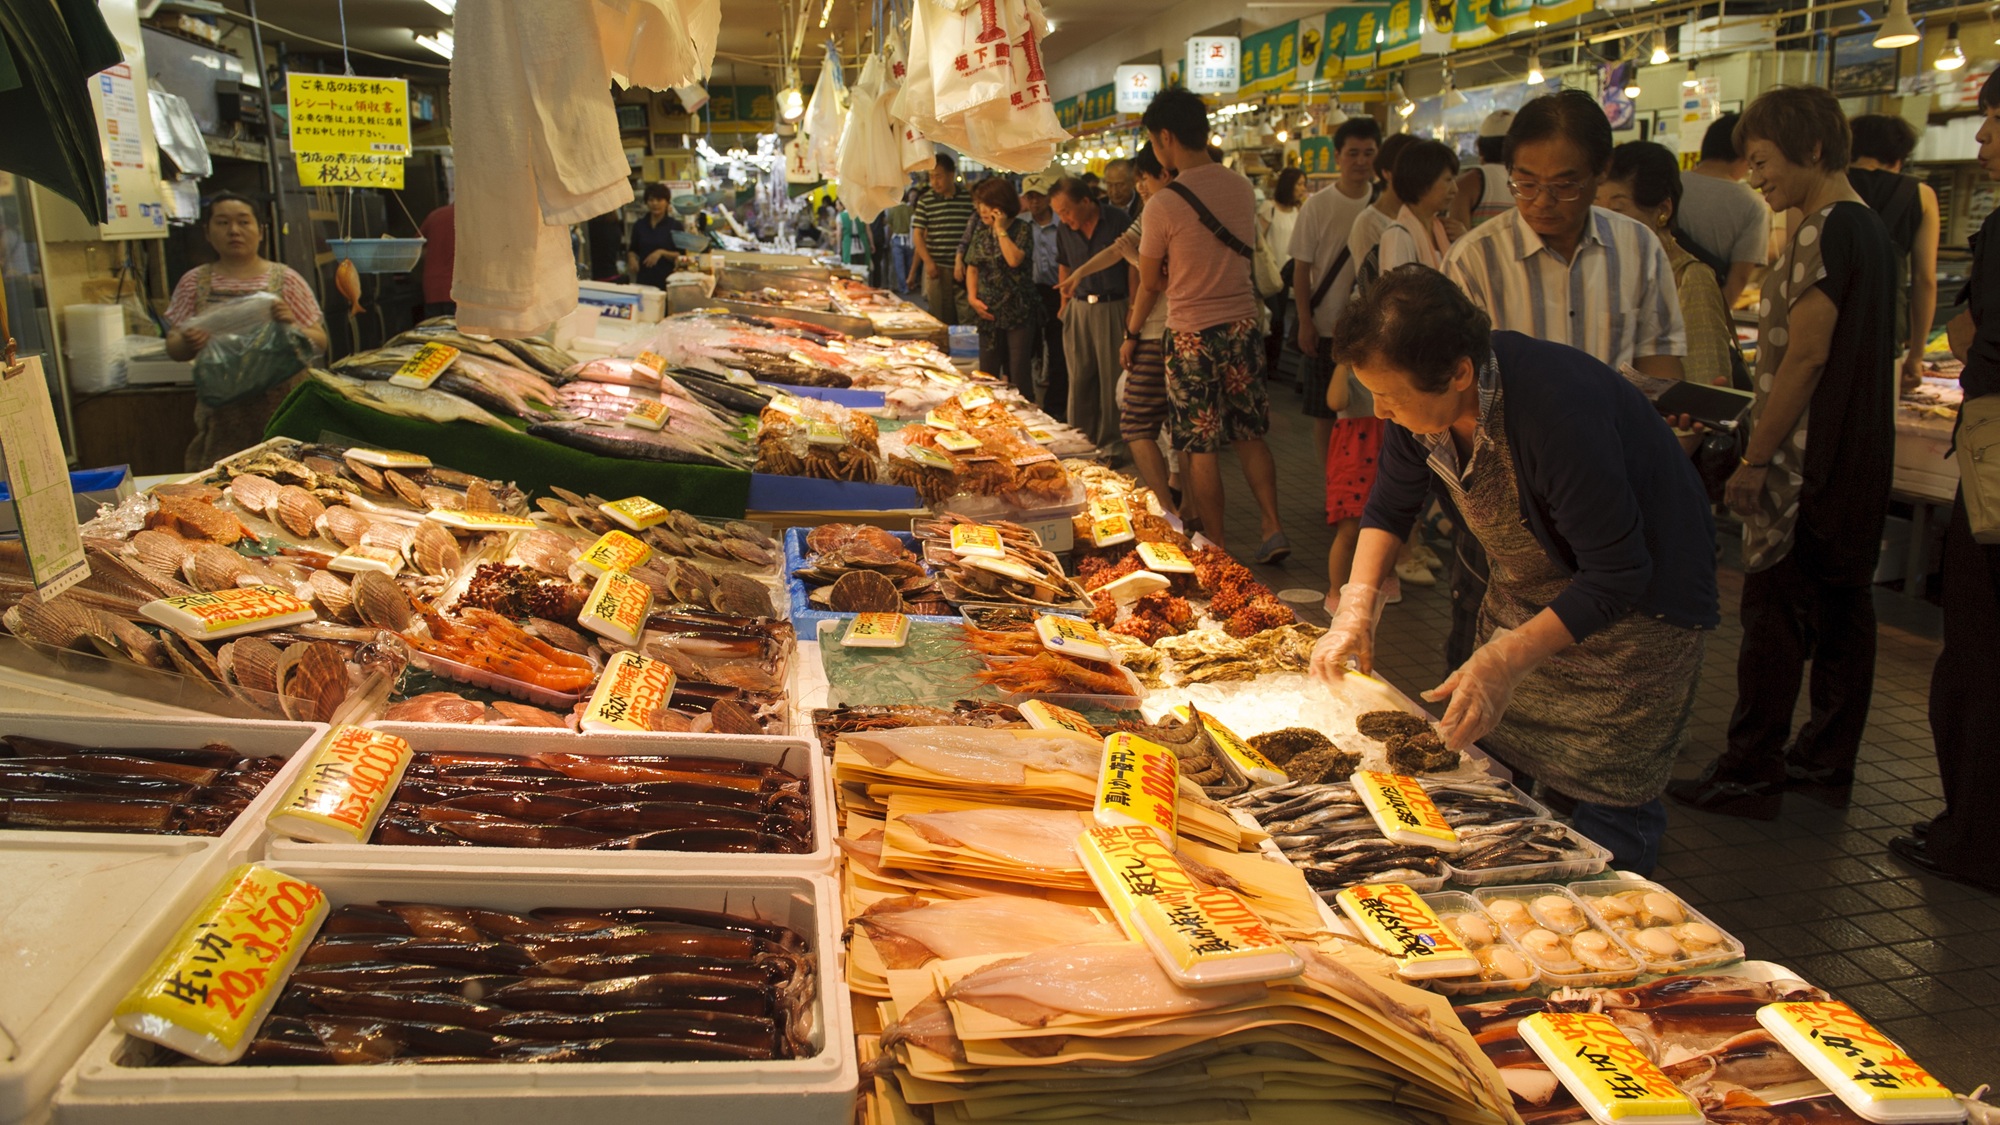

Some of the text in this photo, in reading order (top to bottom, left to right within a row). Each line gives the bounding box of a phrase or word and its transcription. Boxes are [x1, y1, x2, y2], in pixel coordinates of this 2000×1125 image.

[300, 80, 394, 94] ご来店のお客様へ
[1041, 524, 1056, 541] 15
[1103, 749, 1136, 807] 真いか一夜干し
[163, 923, 233, 1005] 生いか
[1575, 1045, 1650, 1100] 生いか
[1809, 1028, 1906, 1089] 生いか
